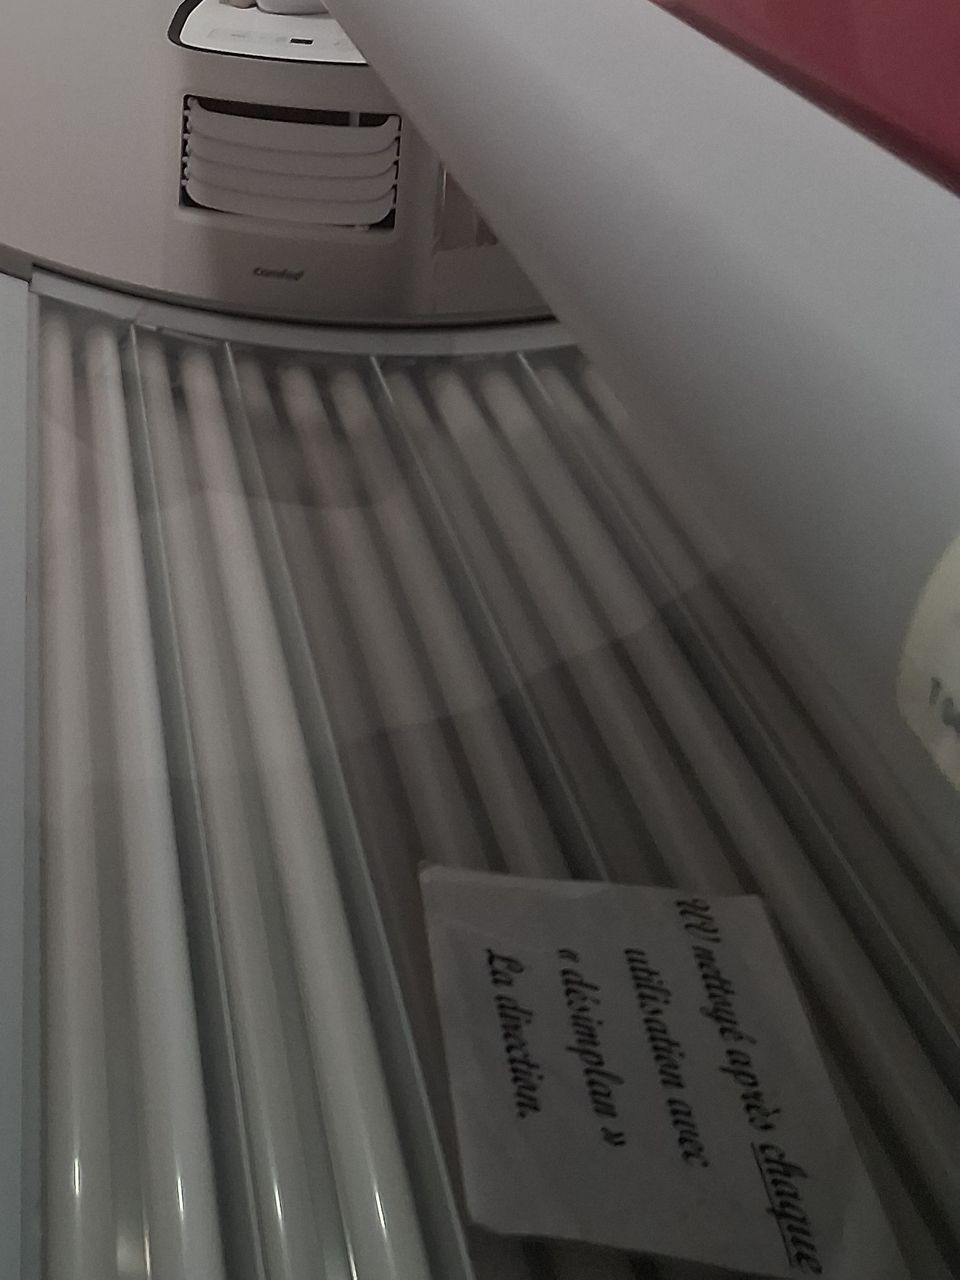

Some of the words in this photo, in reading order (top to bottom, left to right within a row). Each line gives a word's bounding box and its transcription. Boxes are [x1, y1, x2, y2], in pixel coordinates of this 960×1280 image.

[484, 947, 527, 987] La
[624, 947, 686, 1090] utilisation
[666, 1097, 710, 1169] avec
[722, 1049, 780, 1132] après
[752, 1142, 823, 1276] chaque
